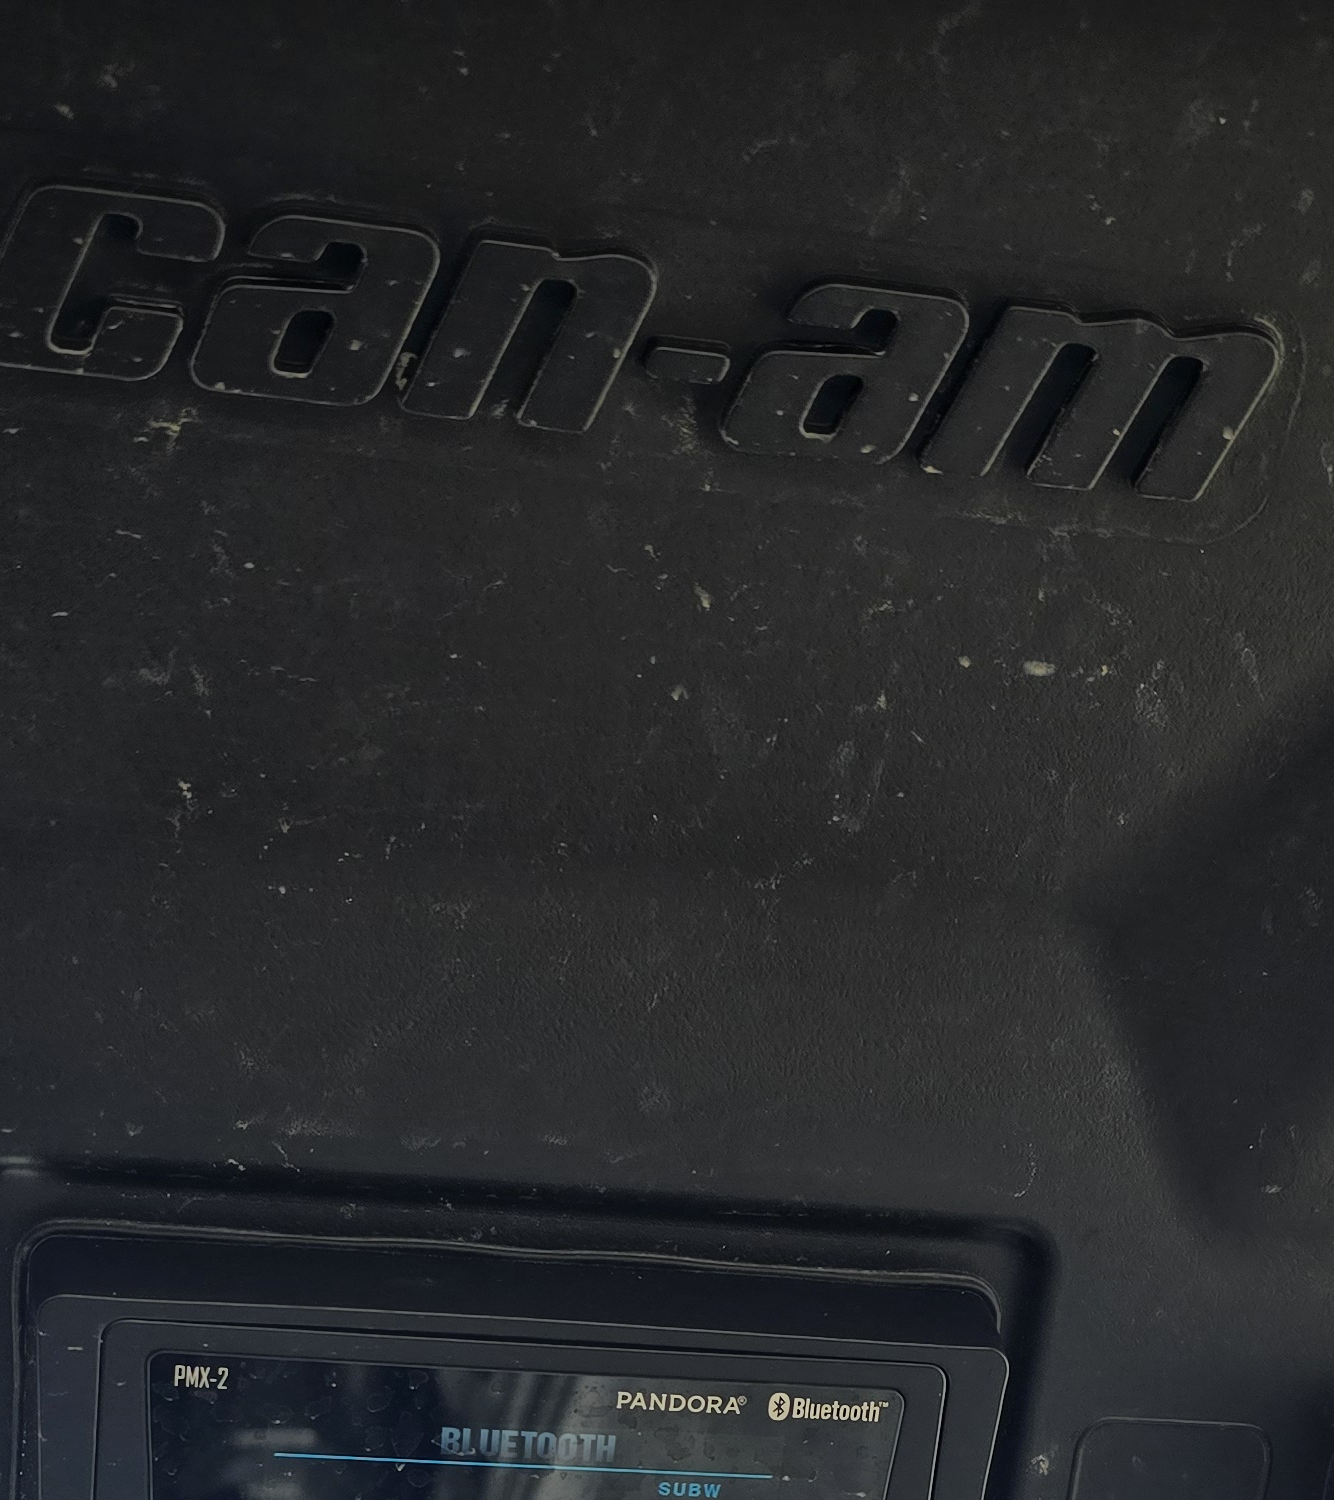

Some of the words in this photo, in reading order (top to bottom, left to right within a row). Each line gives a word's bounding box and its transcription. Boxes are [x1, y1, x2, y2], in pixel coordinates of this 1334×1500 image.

[174, 1364, 229, 1390] PMX-2
[440, 1426, 617, 1463] BLUETOOTH
[657, 1481, 722, 1499] SUBW
